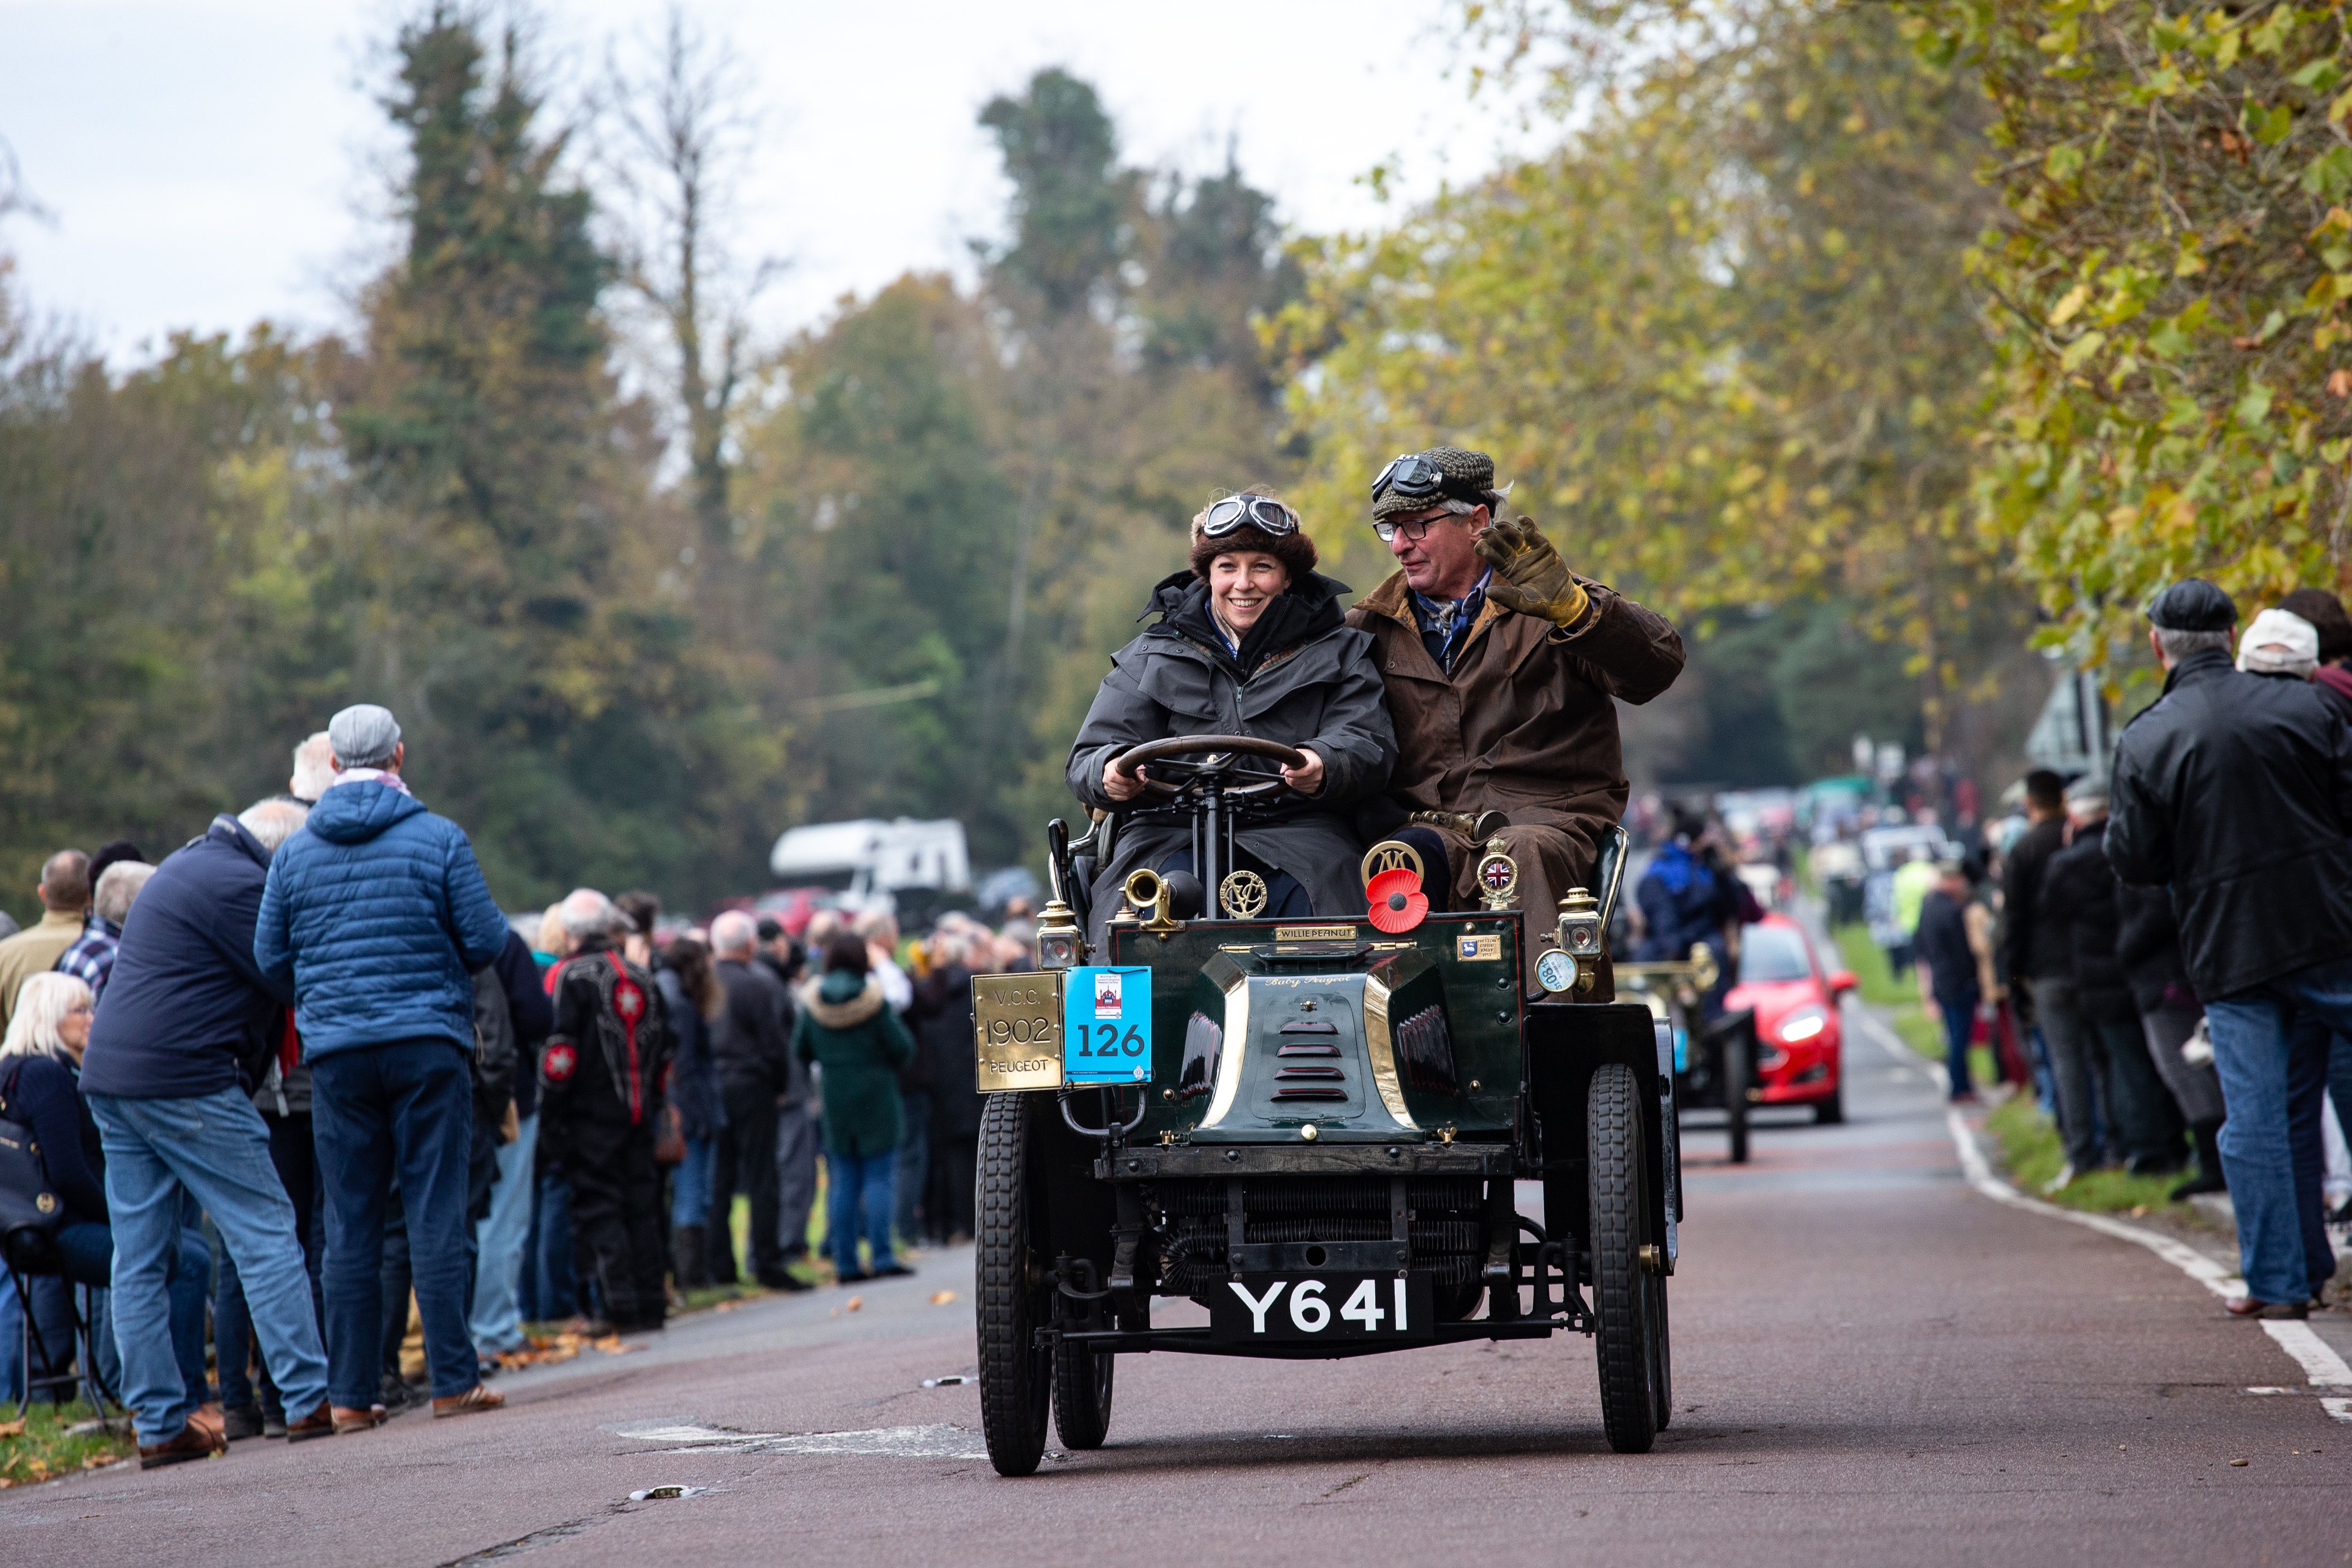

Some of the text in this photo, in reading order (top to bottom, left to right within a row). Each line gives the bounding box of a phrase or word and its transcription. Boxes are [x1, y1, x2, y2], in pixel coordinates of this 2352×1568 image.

[1312, 929, 1351, 937] PEANUT
[1265, 976, 1351, 988] Baby Peugeot
[994, 989, 1040, 1006] V.C.C.
[986, 1017, 1051, 1047] 1902
[1078, 1024, 1145, 1057] 126
[990, 1059, 1049, 1075] PEUGEOT
[1228, 1279, 1407, 1333] Y641
